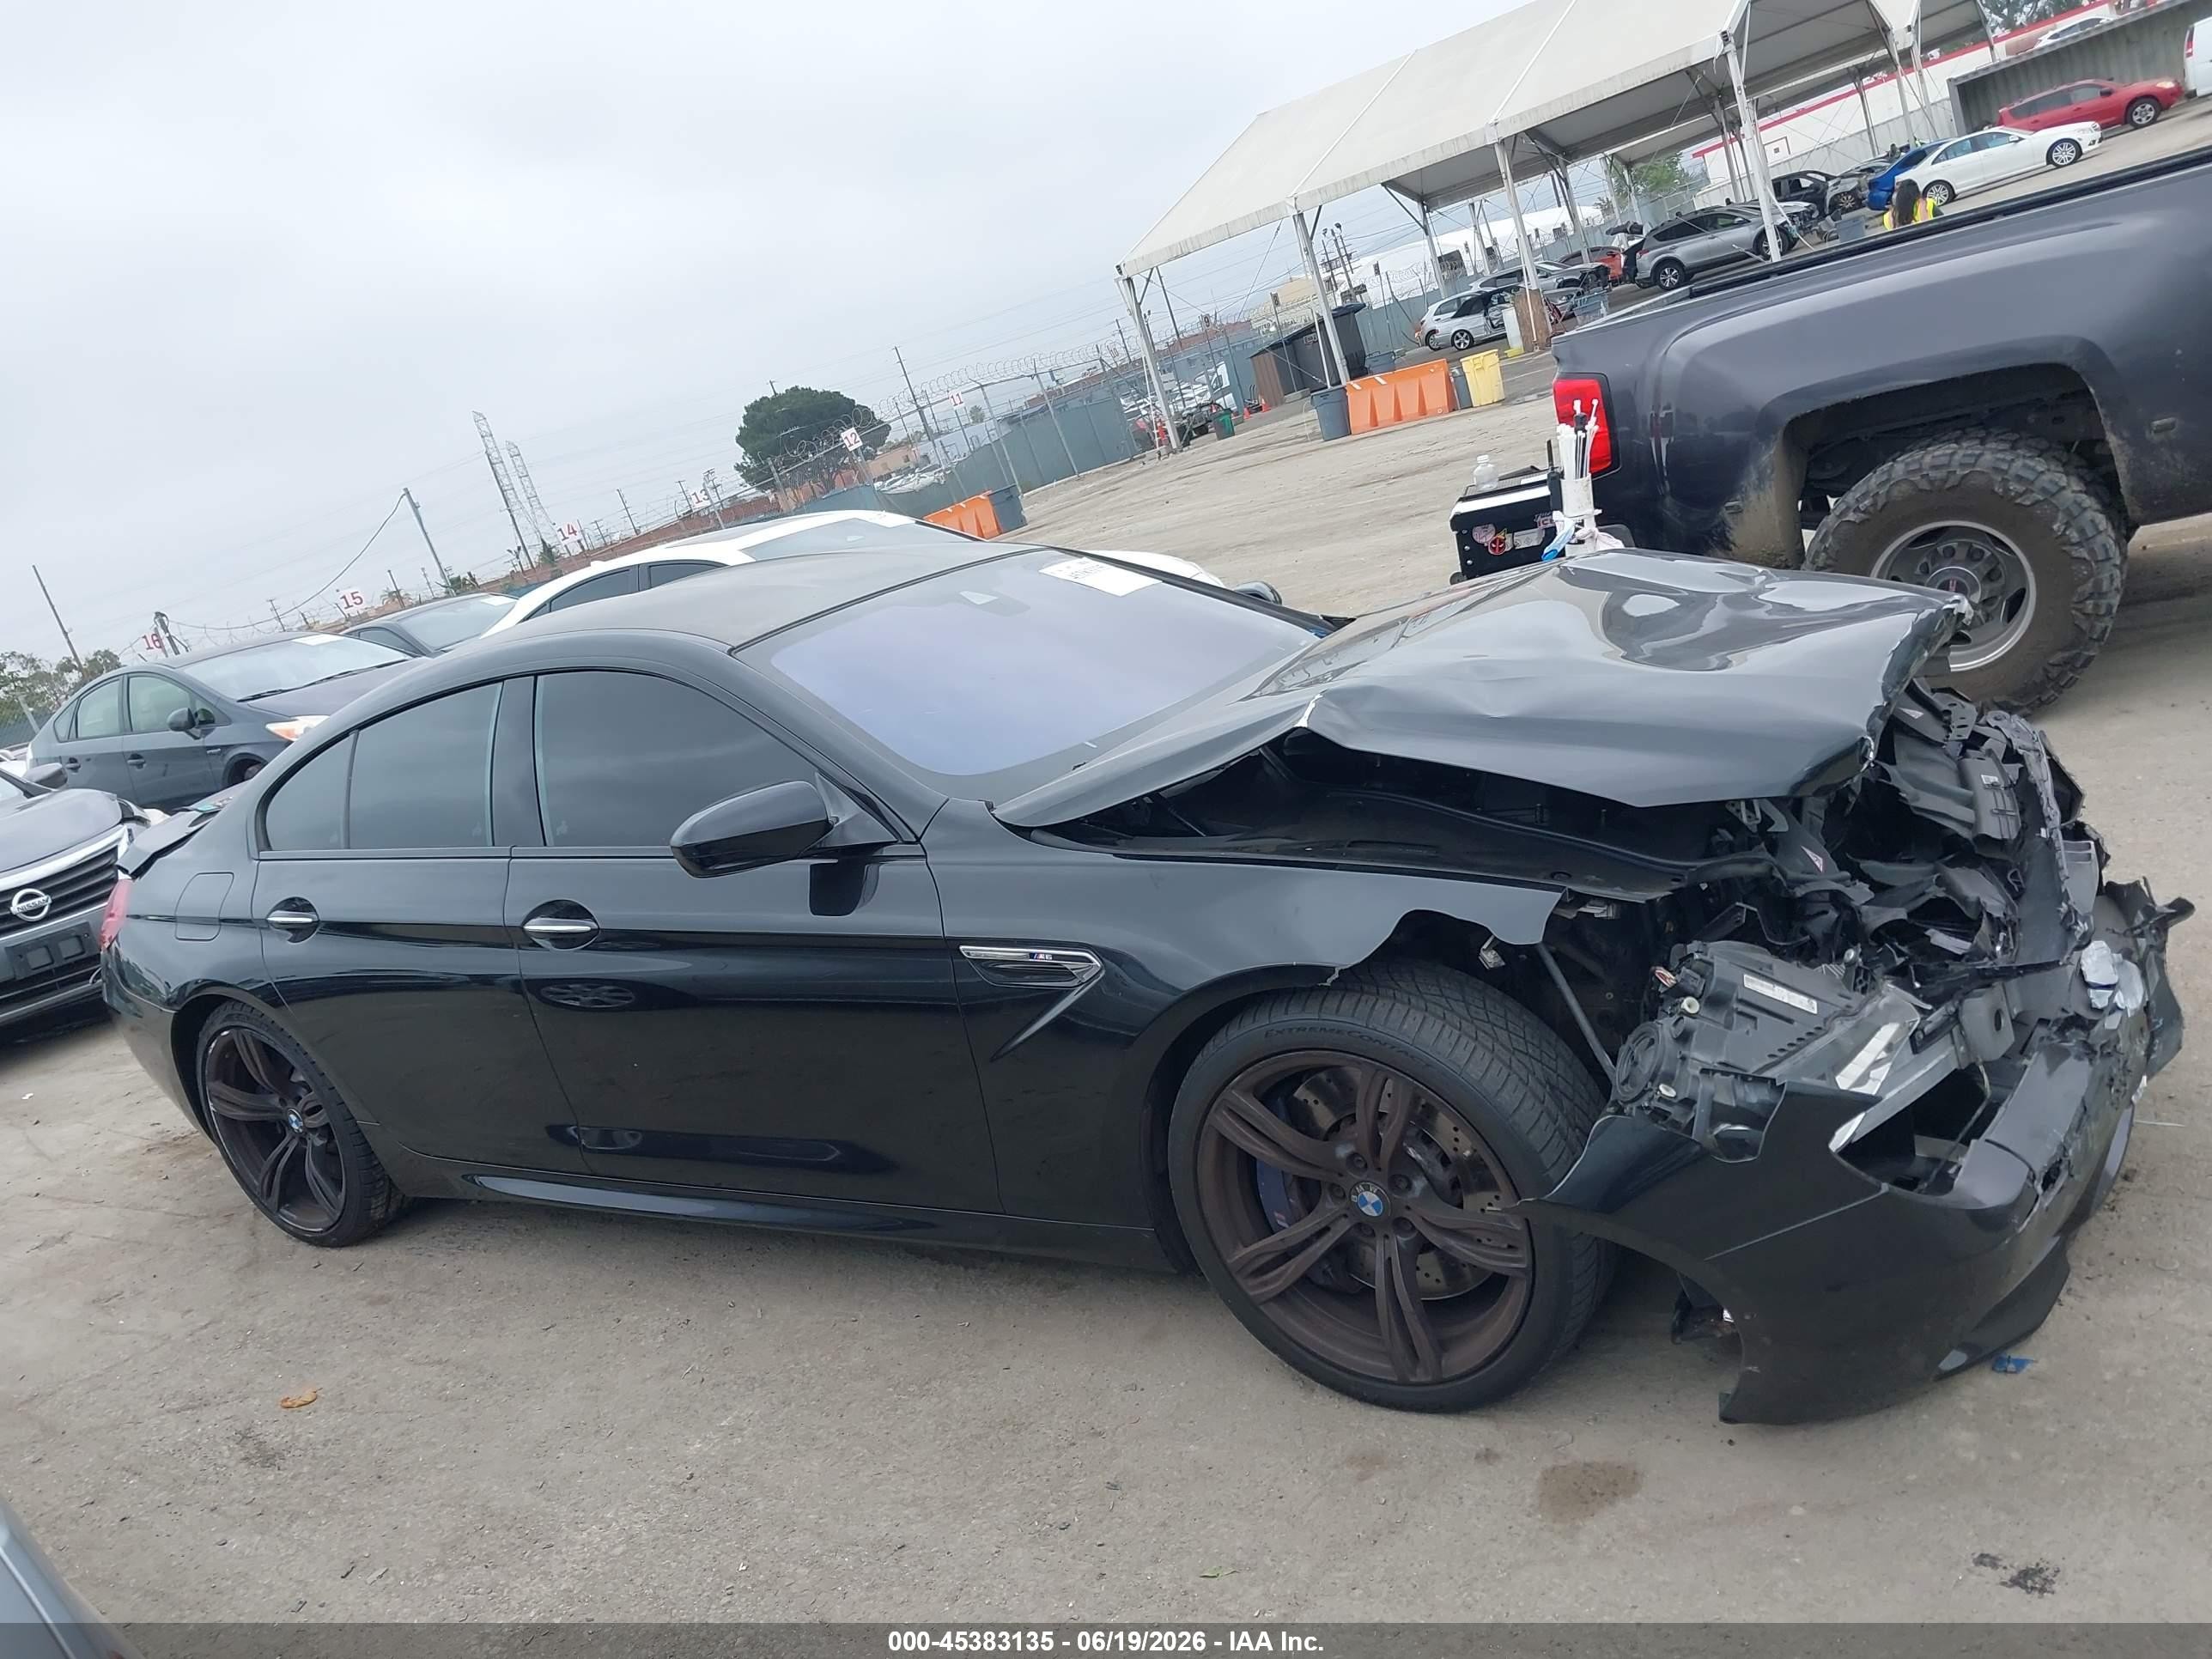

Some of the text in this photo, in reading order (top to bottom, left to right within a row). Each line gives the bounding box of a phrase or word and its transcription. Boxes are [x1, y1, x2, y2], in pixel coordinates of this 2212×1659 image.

[950, 392, 963, 406] 11
[843, 432, 860, 447] 12
[691, 489, 709, 504] 13
[557, 523, 578, 541] 14
[339, 591, 363, 610] 15
[141, 633, 162, 650] 16
[15, 896, 49, 913] NISSAN
